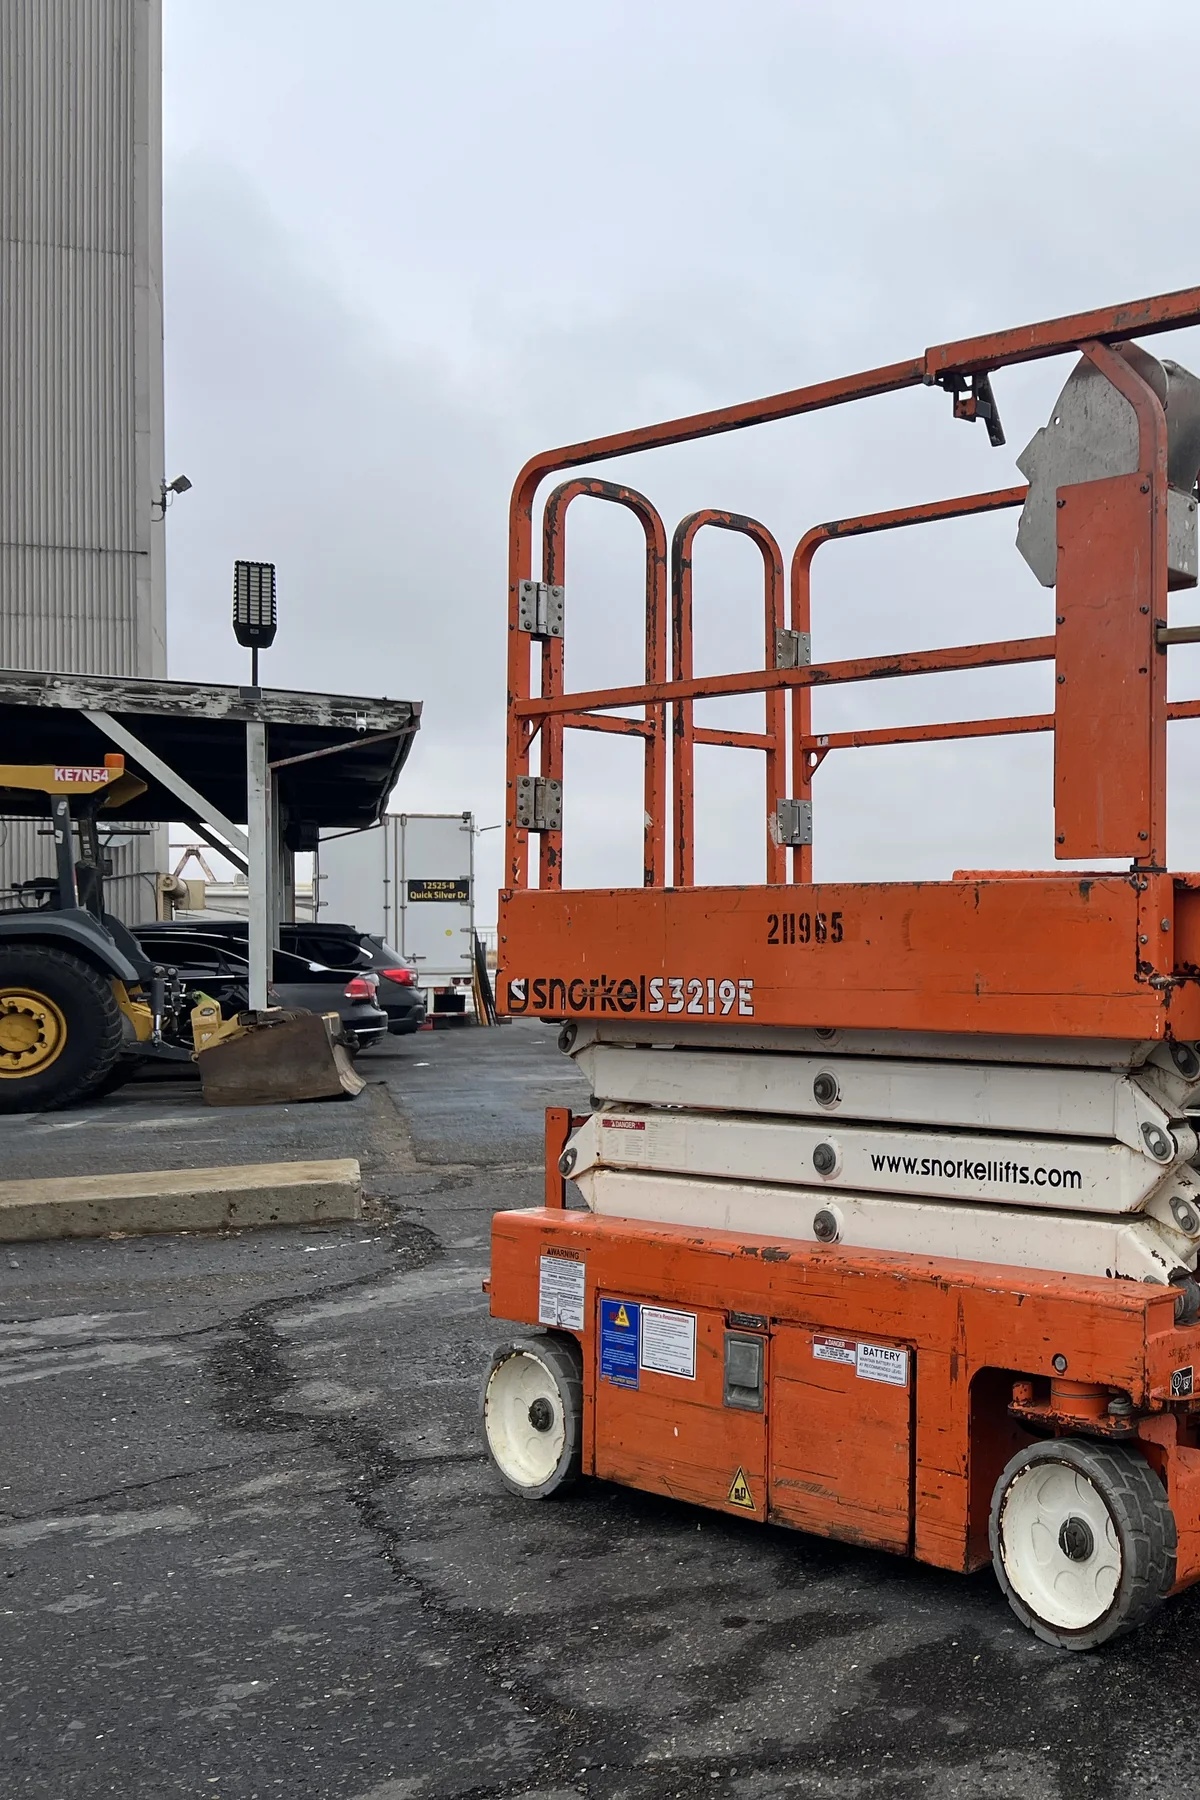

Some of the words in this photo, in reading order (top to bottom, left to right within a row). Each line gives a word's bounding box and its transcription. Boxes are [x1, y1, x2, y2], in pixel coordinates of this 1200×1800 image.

[54, 768, 109, 783] KE7N54
[423, 881, 455, 890] 12525-B
[410, 891, 433, 900] Quick
[434, 891, 456, 899] Silver
[457, 891, 467, 899] Dr
[767, 911, 844, 945] 211965
[532, 974, 646, 1013] snorkel
[648, 976, 755, 1018] S3219E
[615, 1121, 636, 1129] DANGER
[870, 1154, 1083, 1189] www.snorkellifts.com
[549, 1248, 580, 1260] WARNING
[828, 1339, 846, 1348] DANGER
[863, 1346, 901, 1361] BATTERY
